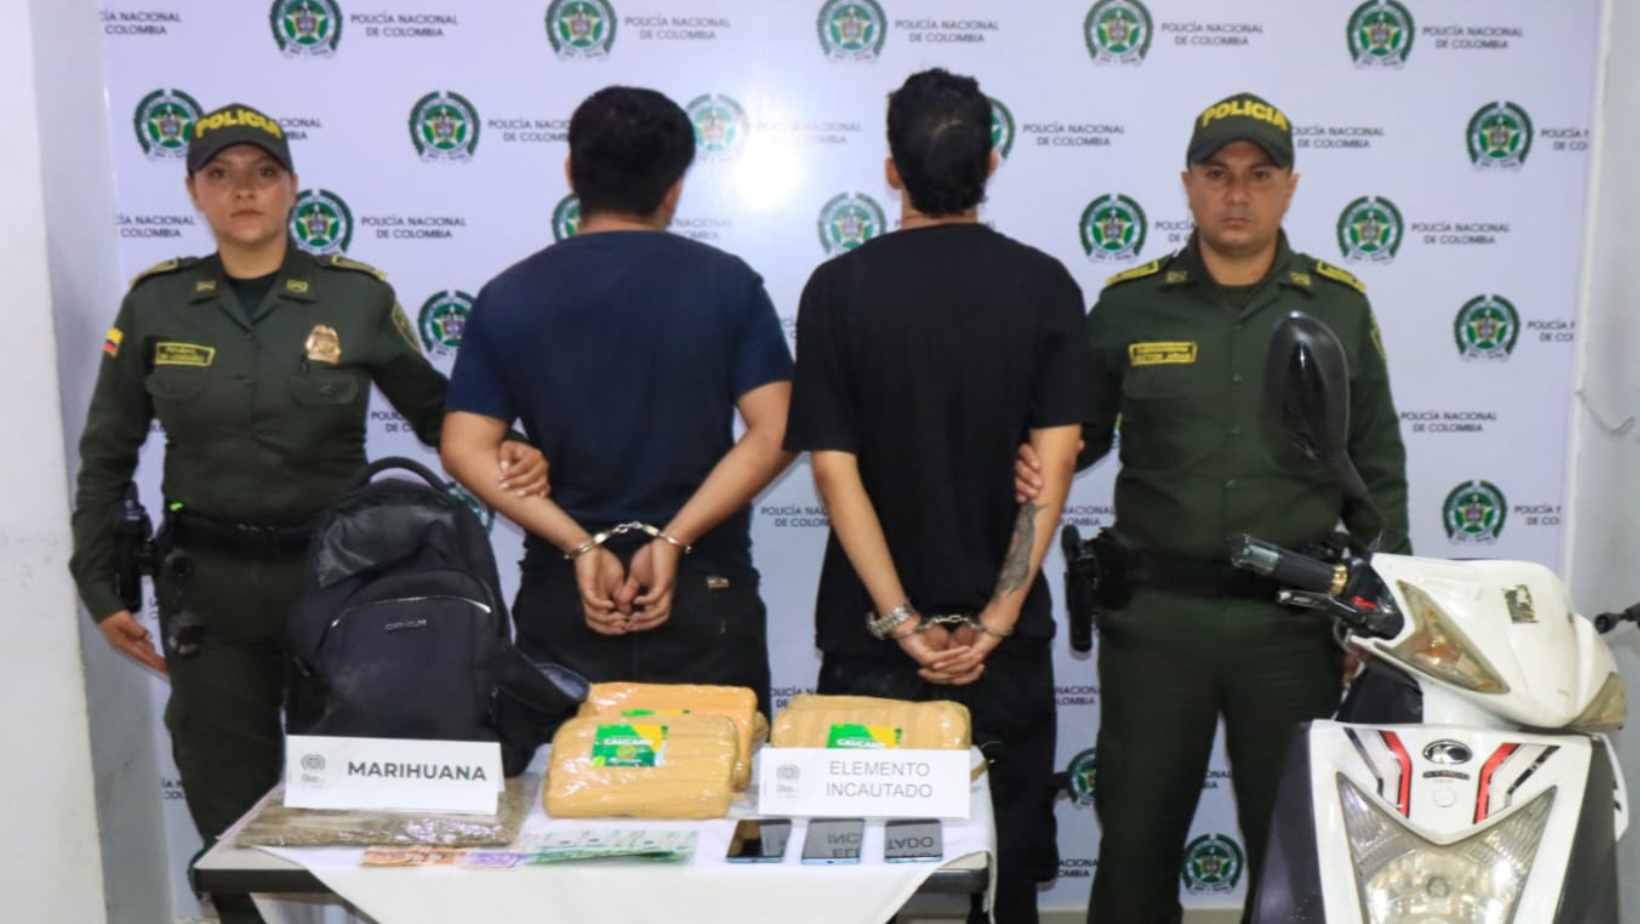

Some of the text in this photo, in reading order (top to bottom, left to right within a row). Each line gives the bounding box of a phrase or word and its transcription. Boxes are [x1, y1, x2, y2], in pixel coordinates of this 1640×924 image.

[119, 12, 181, 23] NACIONAL
[351, 12, 459, 25] POLICÍA NACIONAL
[625, 14, 731, 28] POLICÍA NACIONAL
[895, 17, 1000, 31] POLICÍA NACIONAL
[1161, 20, 1263, 34] POLICÍA NACIONAL
[105, 25, 167, 35] COLOMBIA
[366, 28, 444, 38] DE COLOMBIA
[639, 30, 717, 41] DE COLOMBIA
[1423, 24, 1523, 37] POLICÍA NACIONAL
[909, 33, 985, 43] DE COLOMBIA
[1175, 36, 1249, 46] DE COLOMBIA
[1436, 39, 1509, 50] DE COLOMBIA
[488, 117, 532, 130] POLICÍA
[1023, 122, 1125, 135] POLICÍA NACIONAL
[503, 132, 517, 142] DE
[1329, 126, 1384, 137] NACIONAL
[1541, 126, 1581, 139] POLICÍA
[1037, 136, 1111, 147] DE COLOMBIA
[1297, 138, 1370, 149] DE COLOMBIA
[1553, 141, 1566, 151] DE
[135, 216, 195, 227] NACIONAL
[361, 213, 467, 227] POLICÍA NACIONAL
[1411, 220, 1509, 233] POLICÍA NACIONAL
[120, 228, 181, 238] COLOMBIA
[376, 229, 453, 240] DE COLOMBIA
[1168, 232, 1181, 243] DE
[1424, 235, 1496, 245] DE COLOMBIA
[1528, 318, 1568, 331] POLICÍA
[1539, 332, 1553, 342] DE
[1401, 409, 1497, 422] POLICÍA NACIONAL
[386, 423, 398, 432] DE
[1413, 423, 1483, 433] DE COLOMBIA
[761, 503, 802, 516] POLICÍA
[1514, 503, 1553, 516] POLICÍA
[775, 518, 787, 528] DE
[1526, 516, 1539, 526] DE
[347, 761, 488, 782] MARIHUANA
[829, 760, 931, 778] ELEMENTO
[826, 782, 934, 799] INCAUTADO
